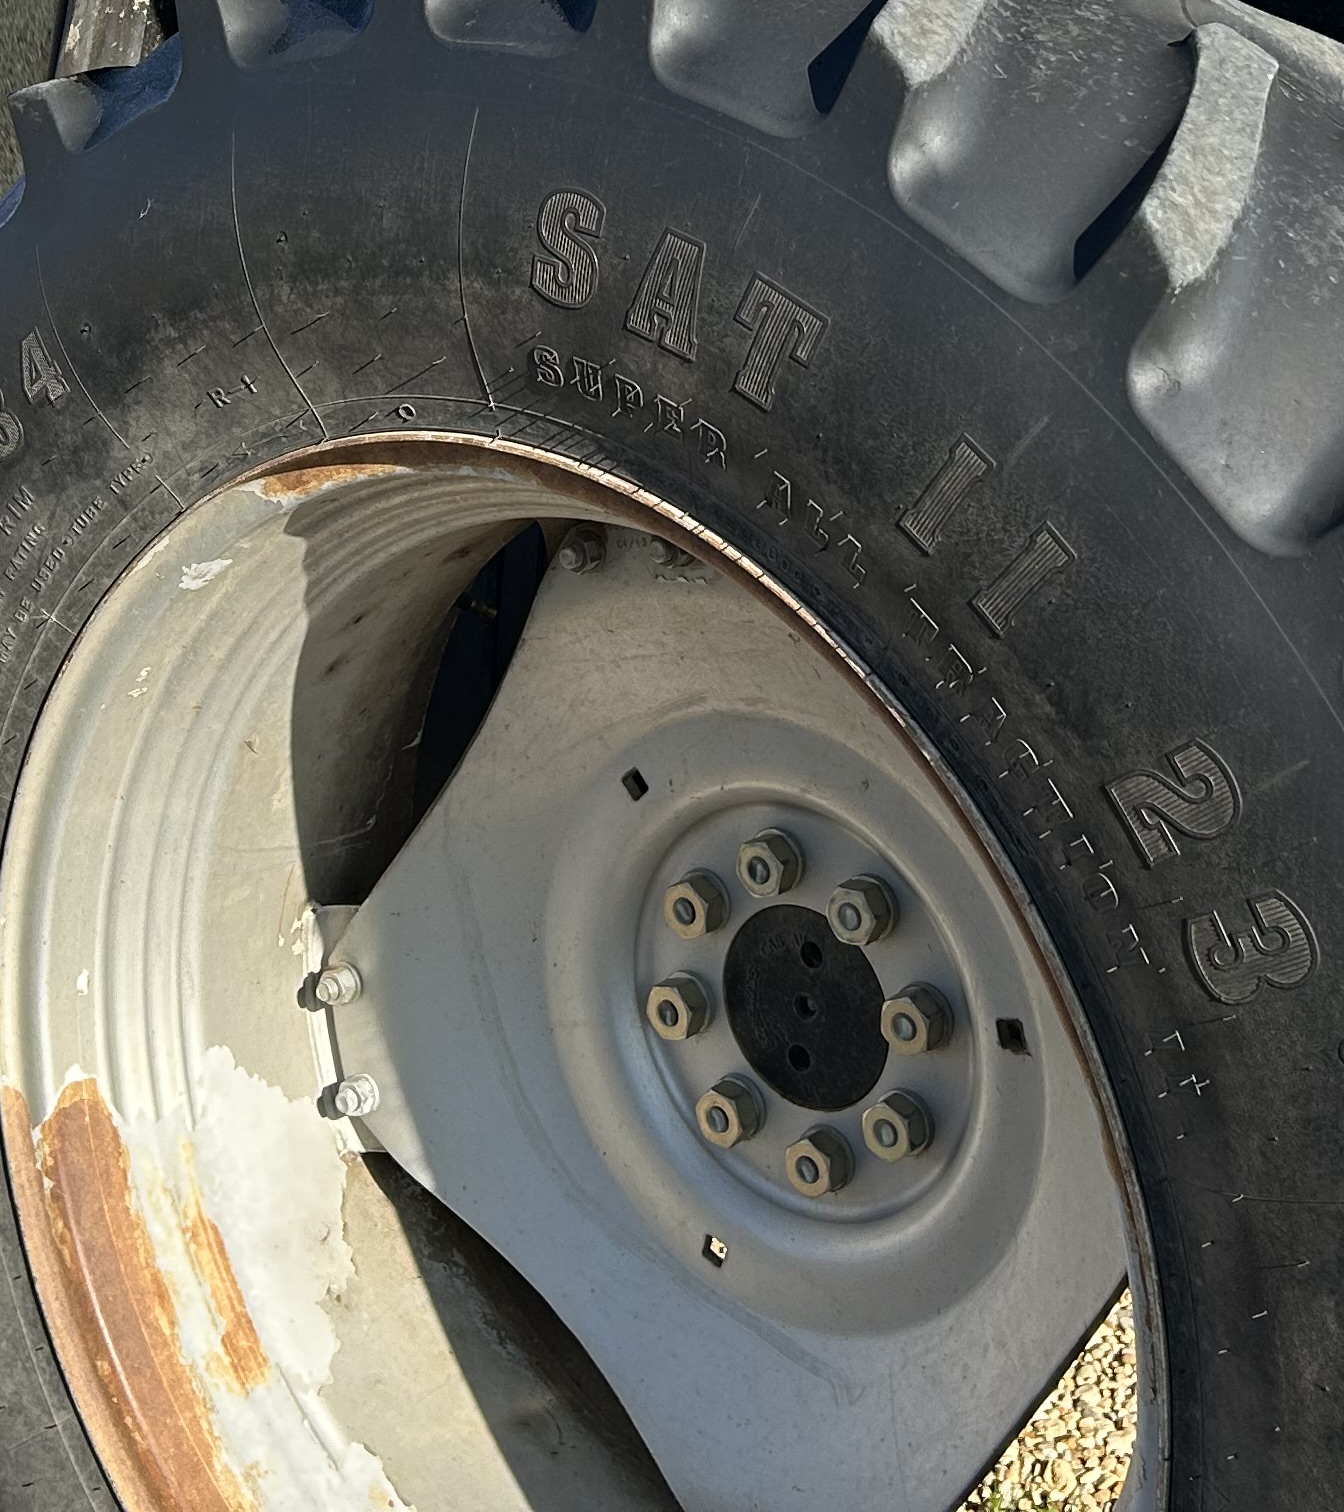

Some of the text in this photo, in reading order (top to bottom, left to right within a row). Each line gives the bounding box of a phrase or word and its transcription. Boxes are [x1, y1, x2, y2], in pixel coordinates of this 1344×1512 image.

[530, 187, 832, 412] SAT
[4, 522, 47, 582] RATING
[533, 344, 728, 471] SUPER
[757, 471, 867, 589] ALL
[14, 597, 38, 624] BE
[30, 546, 67, 593] USED
[71, 494, 109, 539] TUBE
